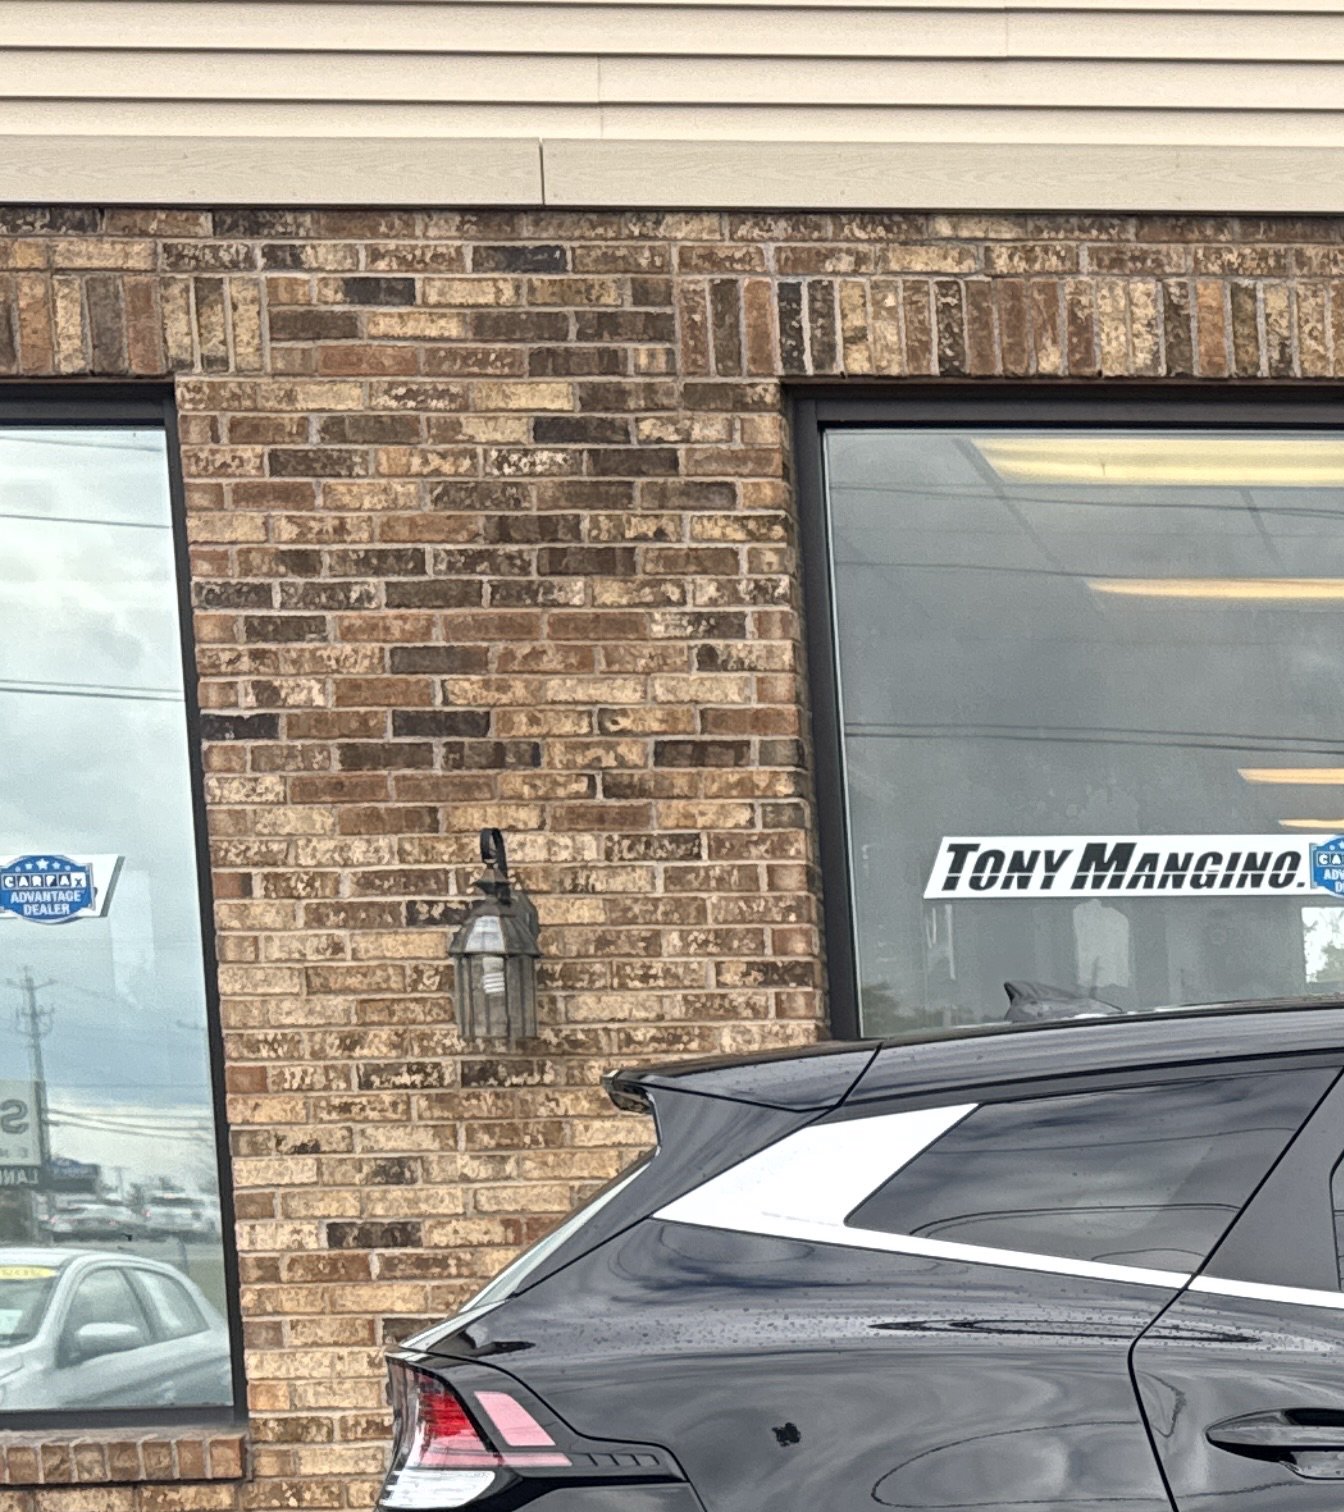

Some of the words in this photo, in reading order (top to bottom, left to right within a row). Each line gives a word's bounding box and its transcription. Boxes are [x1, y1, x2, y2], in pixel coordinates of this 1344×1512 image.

[3, 872, 87, 888] CARFAX
[10, 889, 82, 903] ADVANTAGE
[22, 903, 70, 915] DEALER
